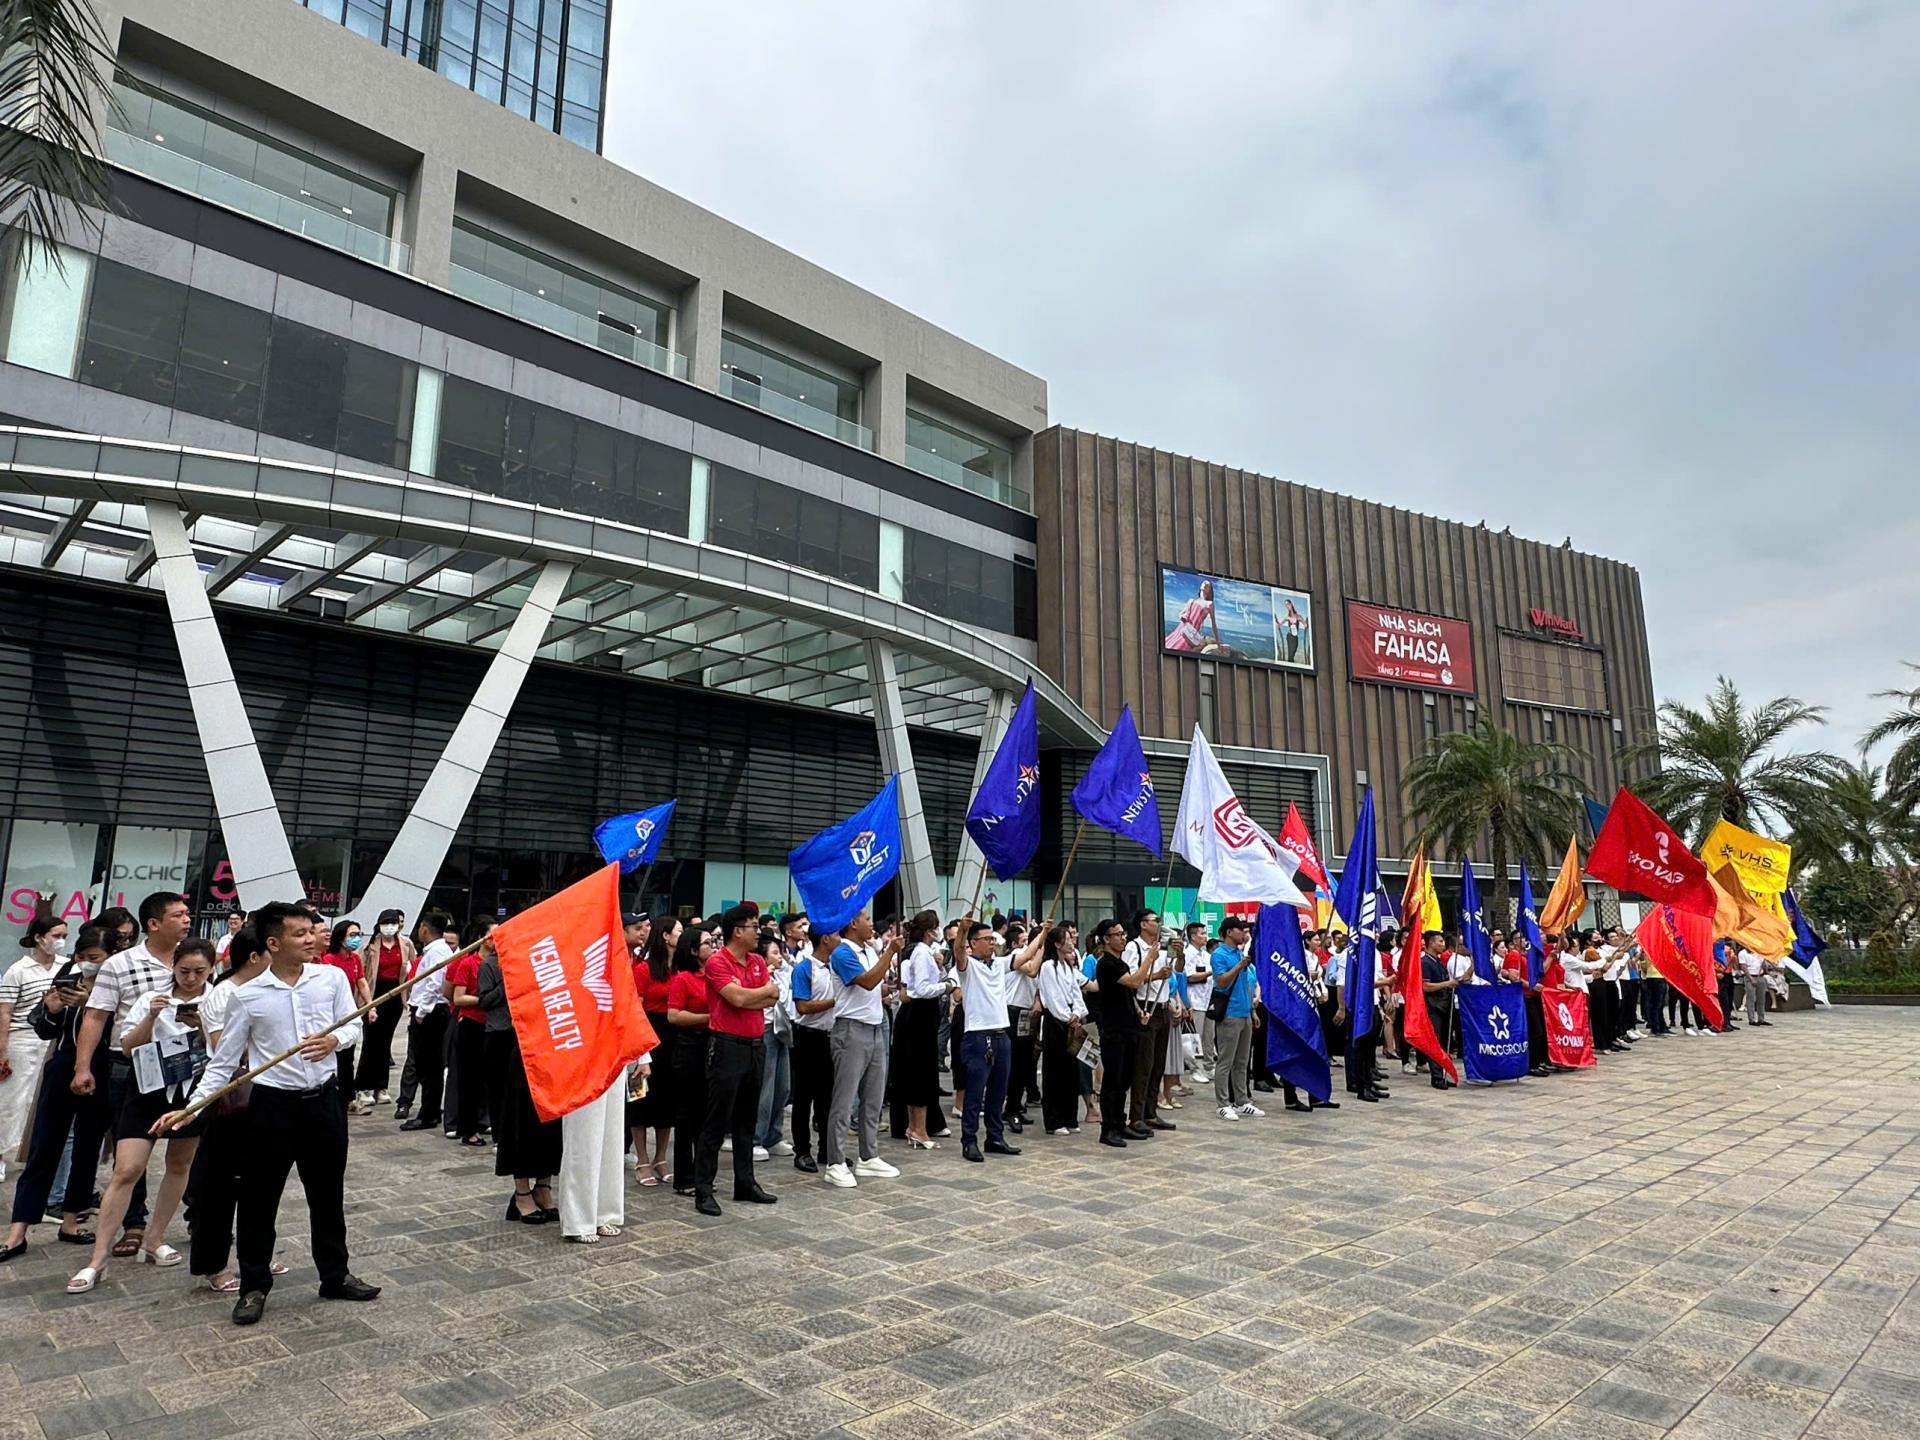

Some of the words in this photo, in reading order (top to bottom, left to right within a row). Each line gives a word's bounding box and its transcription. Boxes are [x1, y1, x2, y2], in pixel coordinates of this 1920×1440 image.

[1378, 613, 1407, 632] NHÀ
[1374, 631, 1451, 667] FAHASA
[1394, 667, 1401, 677] 2
[112, 864, 183, 881] D.CHIC
[1740, 850, 1773, 869] VHS
[528, 935, 567, 993] VISION
[1270, 951, 1314, 997] DIAMOND
[542, 990, 583, 1051] REALTY
